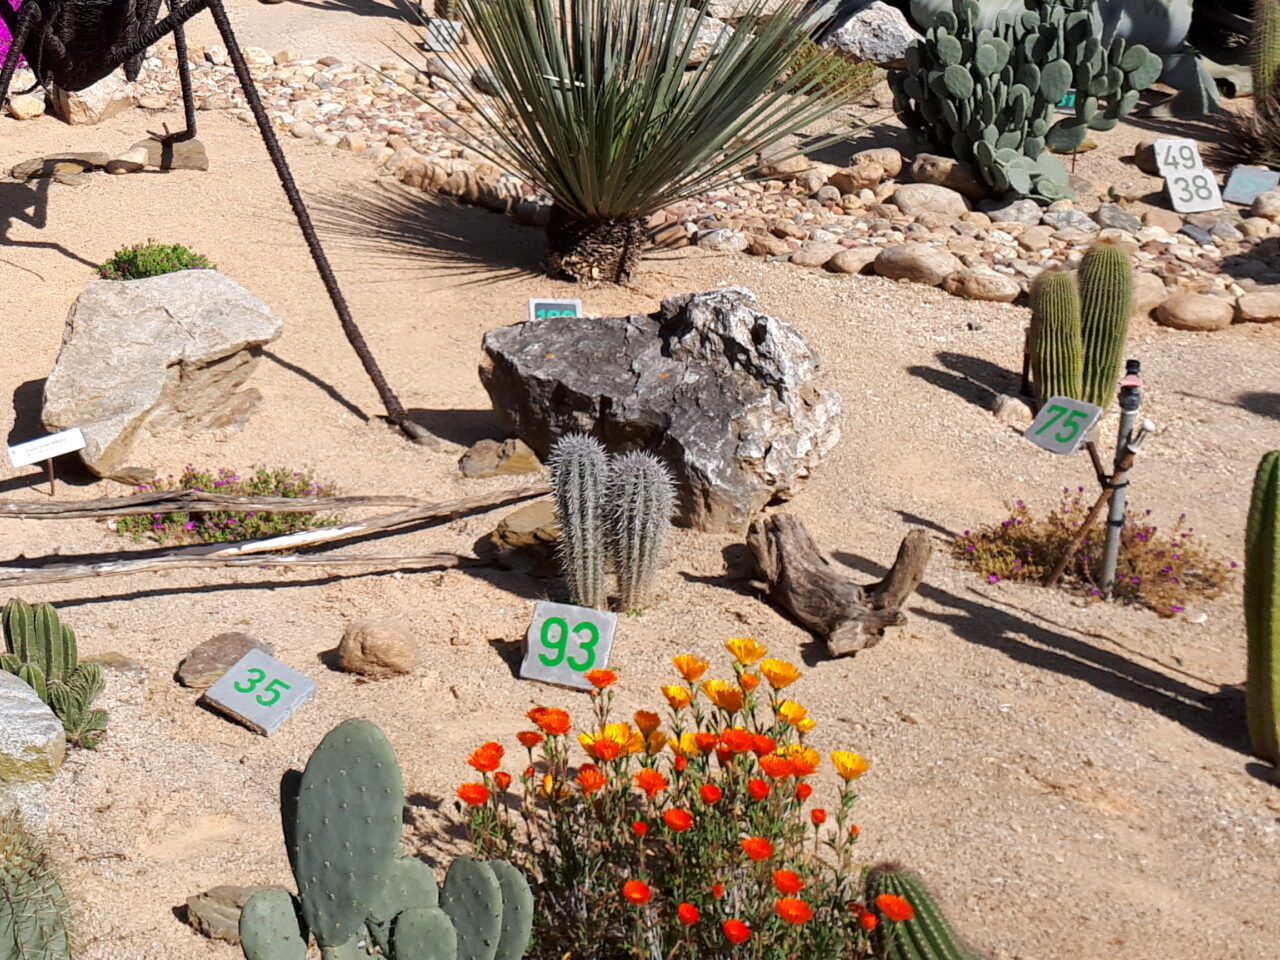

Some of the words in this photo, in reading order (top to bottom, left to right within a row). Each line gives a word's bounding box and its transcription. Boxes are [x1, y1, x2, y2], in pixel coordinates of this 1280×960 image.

[1163, 145, 1196, 170] 49
[1173, 175, 1213, 203] 38
[1034, 404, 1089, 444] 75
[538, 616, 600, 672] 93
[233, 667, 291, 707] 35
